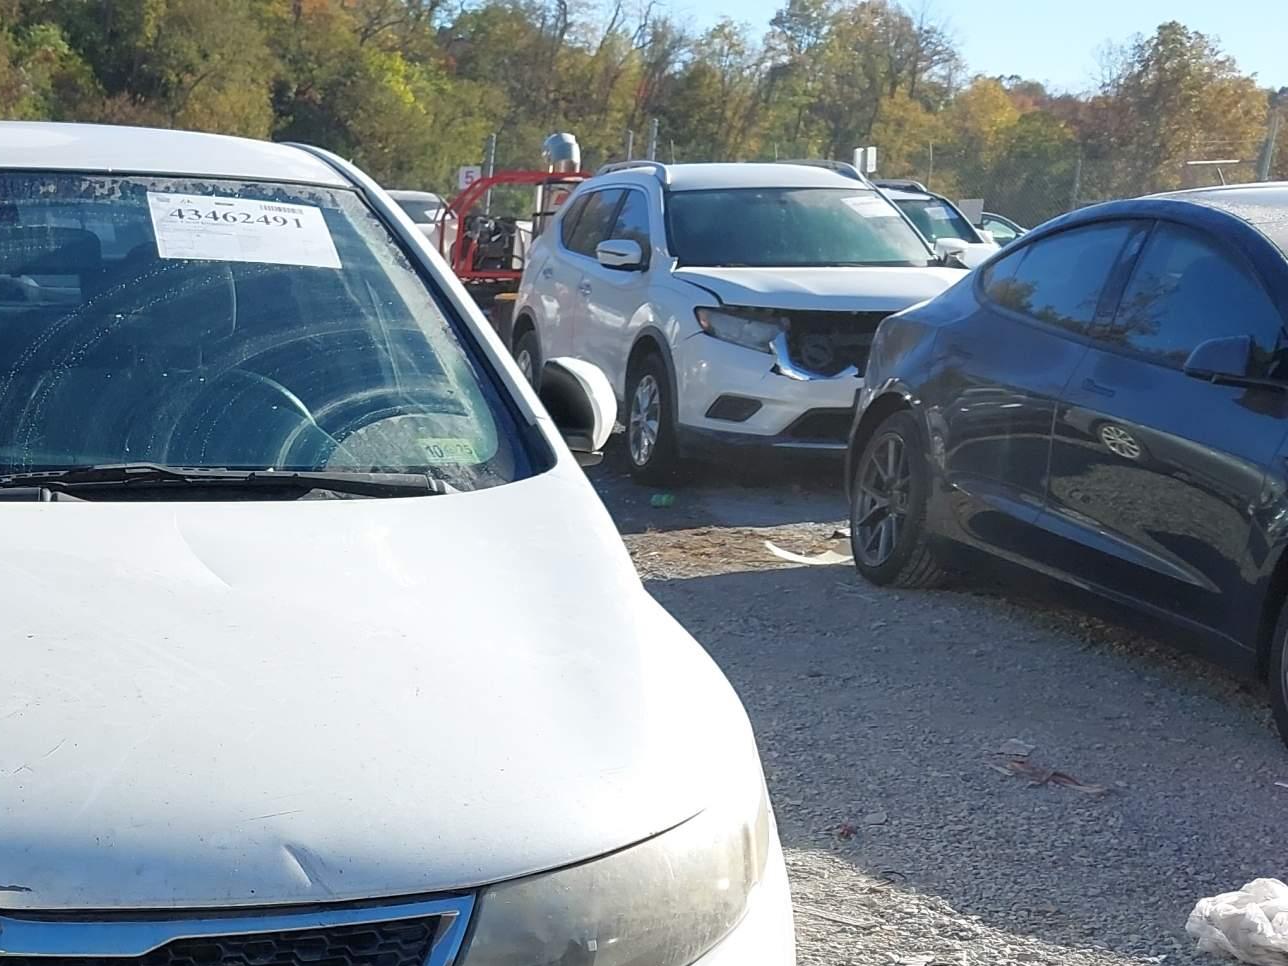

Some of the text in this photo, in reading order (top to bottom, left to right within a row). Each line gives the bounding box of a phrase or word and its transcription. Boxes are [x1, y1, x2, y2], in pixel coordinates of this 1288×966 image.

[464, 170, 474, 185] 5
[169, 208, 303, 229] 43462491
[425, 444, 444, 458] 10
